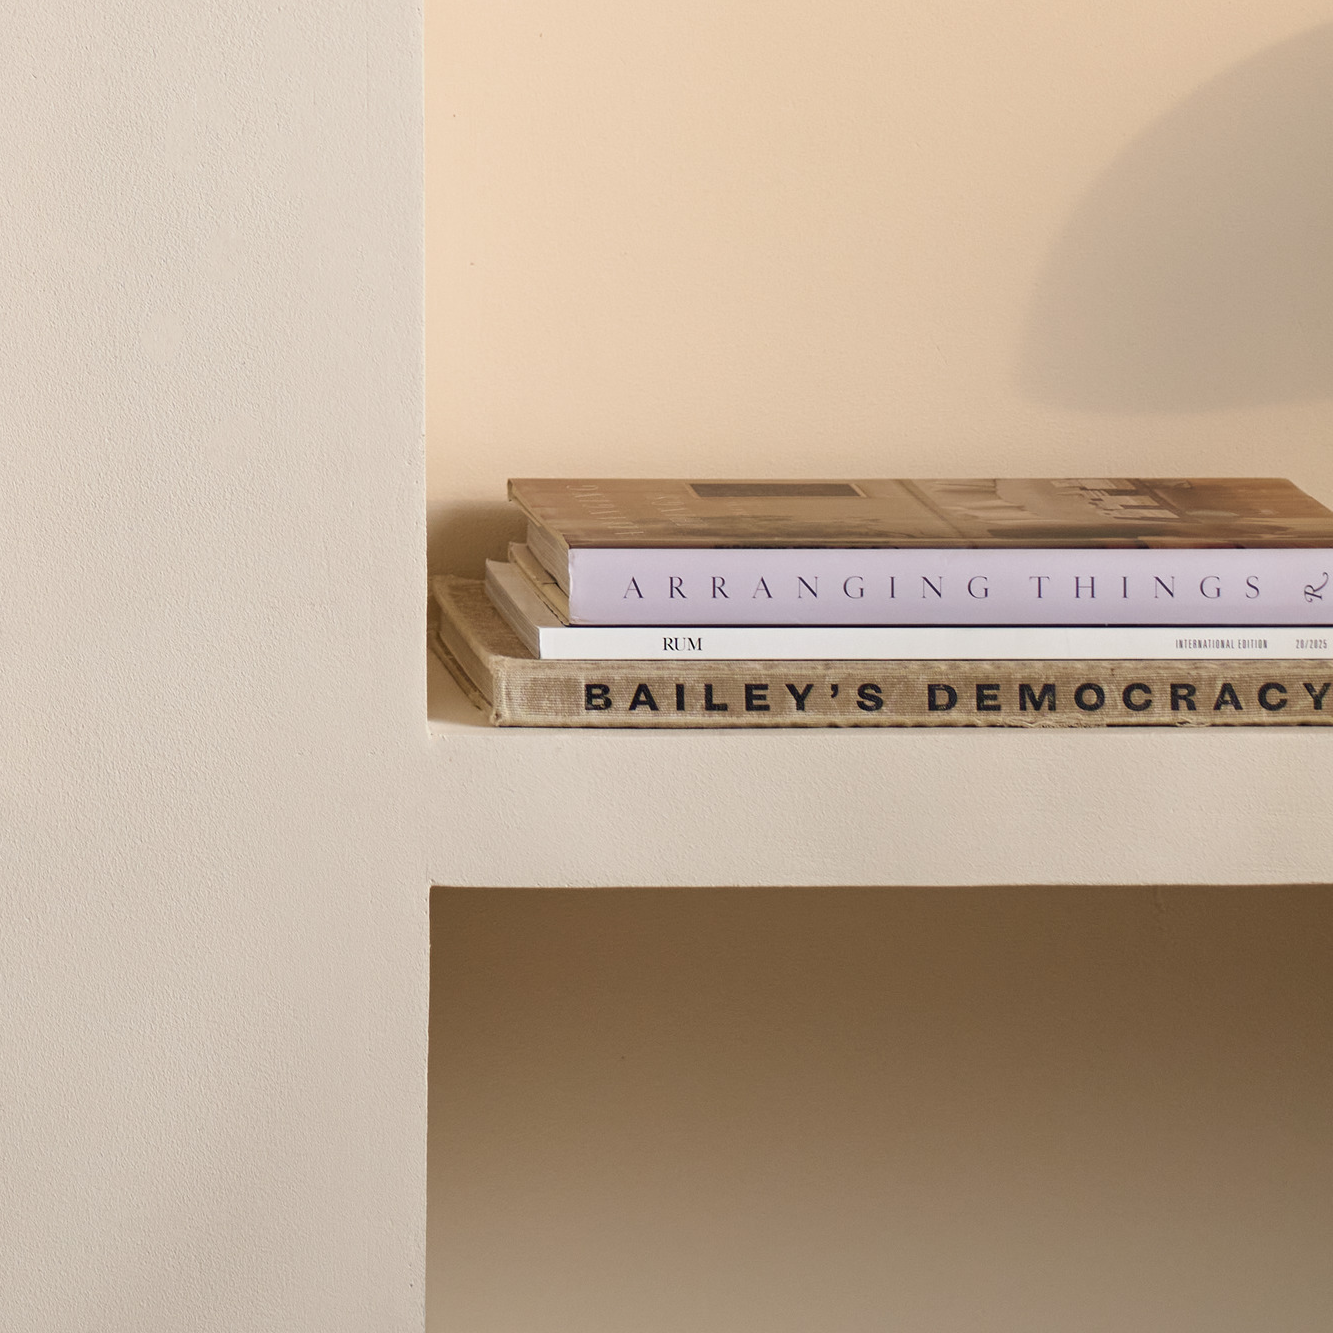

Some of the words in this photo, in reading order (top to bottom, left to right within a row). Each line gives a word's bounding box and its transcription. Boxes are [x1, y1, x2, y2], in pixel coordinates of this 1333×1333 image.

[622, 575, 989, 600] ARRANGING
[1028, 575, 1261, 600] THINGS
[662, 636, 703, 652] RUM
[1175, 638, 1235, 650] INTERNATIONAL
[1237, 638, 1268, 650] EDITION
[928, 682, 1332, 712] DEMOCRACY
